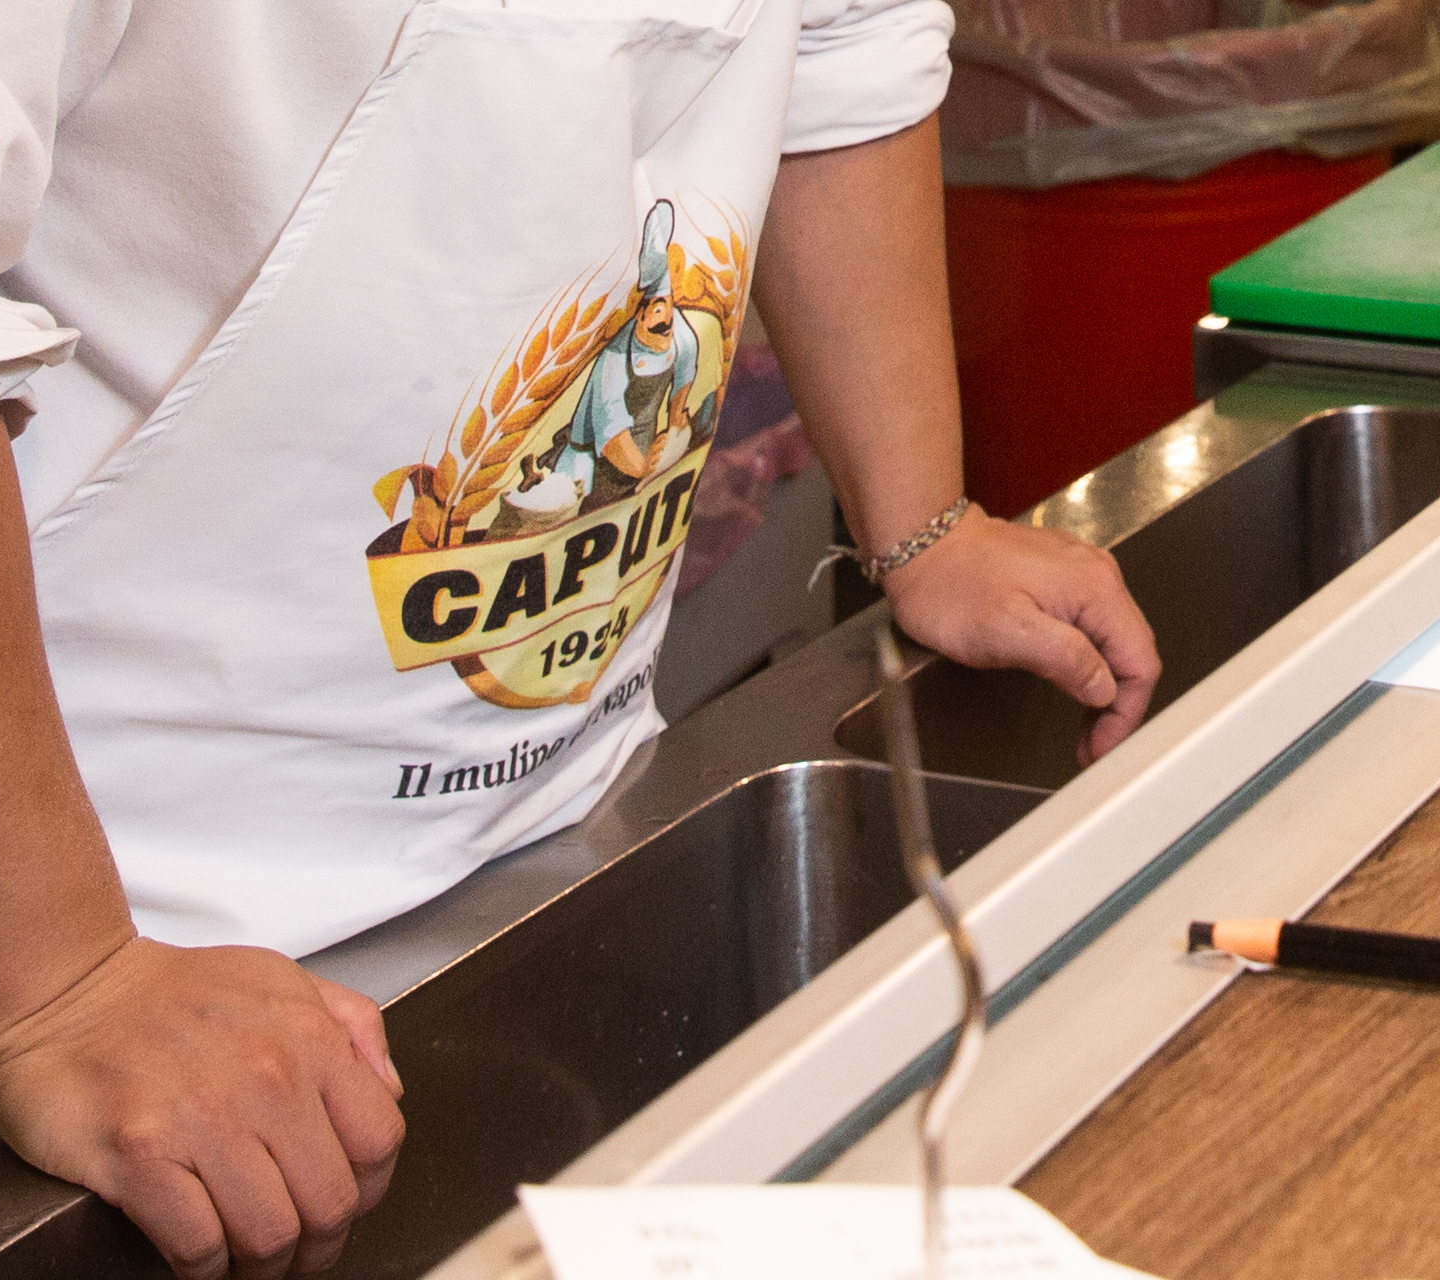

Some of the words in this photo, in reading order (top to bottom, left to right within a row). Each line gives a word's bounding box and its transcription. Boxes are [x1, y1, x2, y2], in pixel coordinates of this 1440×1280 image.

[401, 468, 699, 644] CAPUT
[540, 604, 630, 678] 1924
[392, 761, 432, 799] Il
